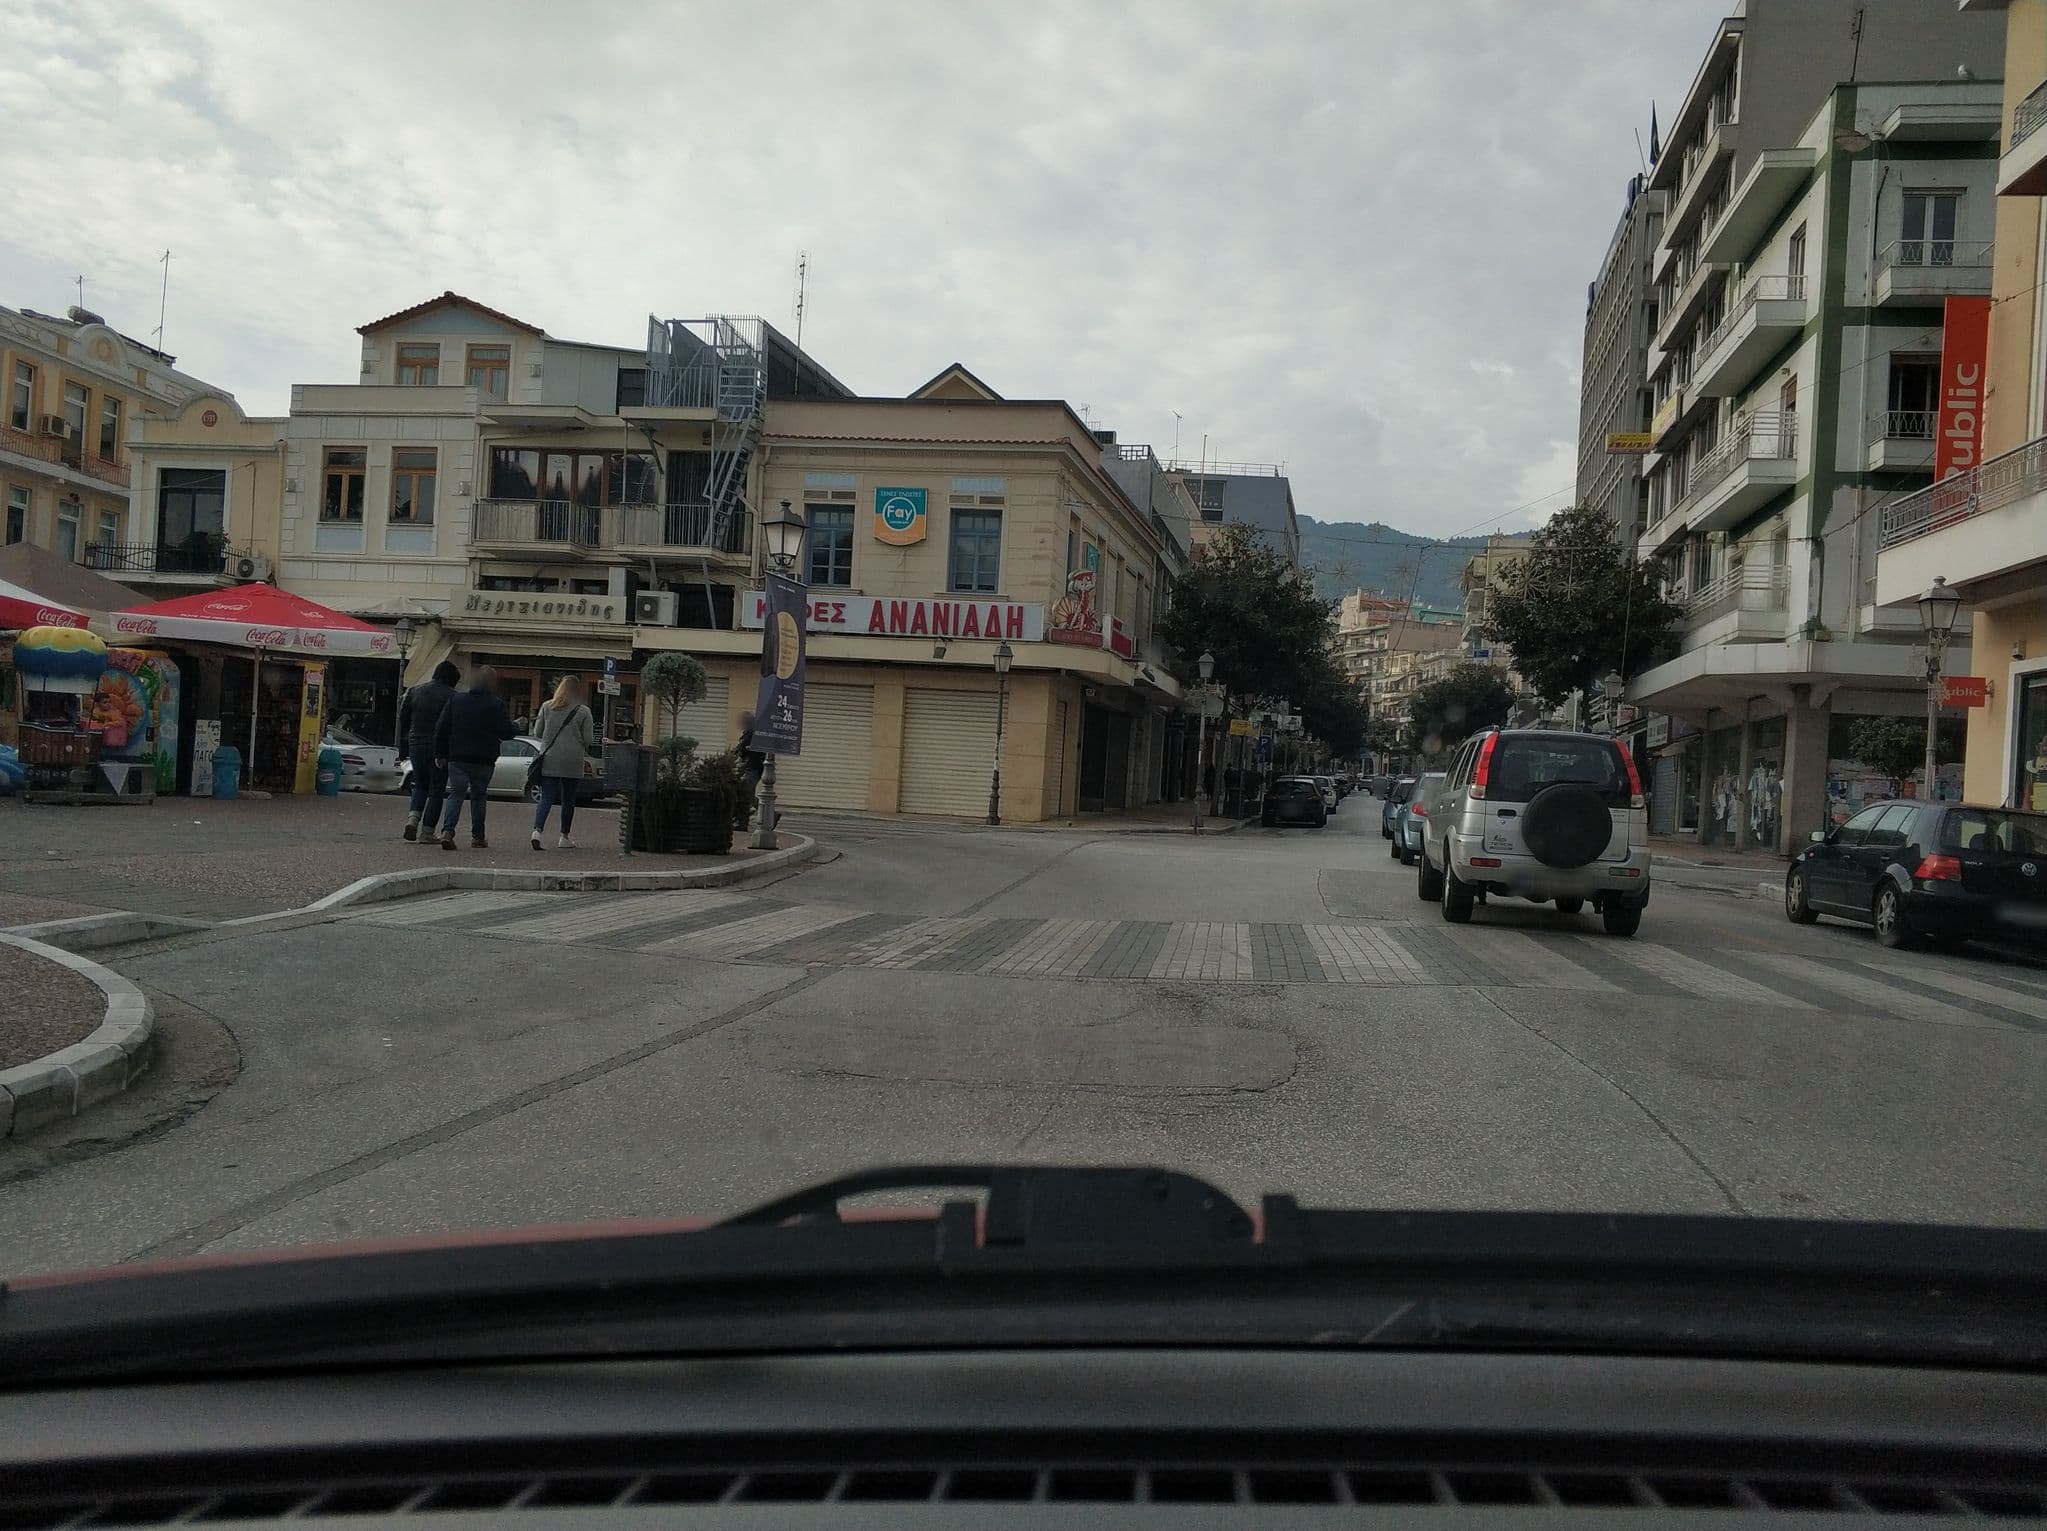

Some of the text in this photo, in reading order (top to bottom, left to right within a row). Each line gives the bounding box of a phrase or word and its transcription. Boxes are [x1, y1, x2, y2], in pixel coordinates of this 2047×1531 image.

[887, 505, 913, 521] Fay
[757, 599, 1024, 639] ΚΕΣ ΑΝΑΝΙΑΔΗ
[607, 660, 613, 671] P
[778, 695, 787, 707] 24
[783, 709, 792, 722] 26
